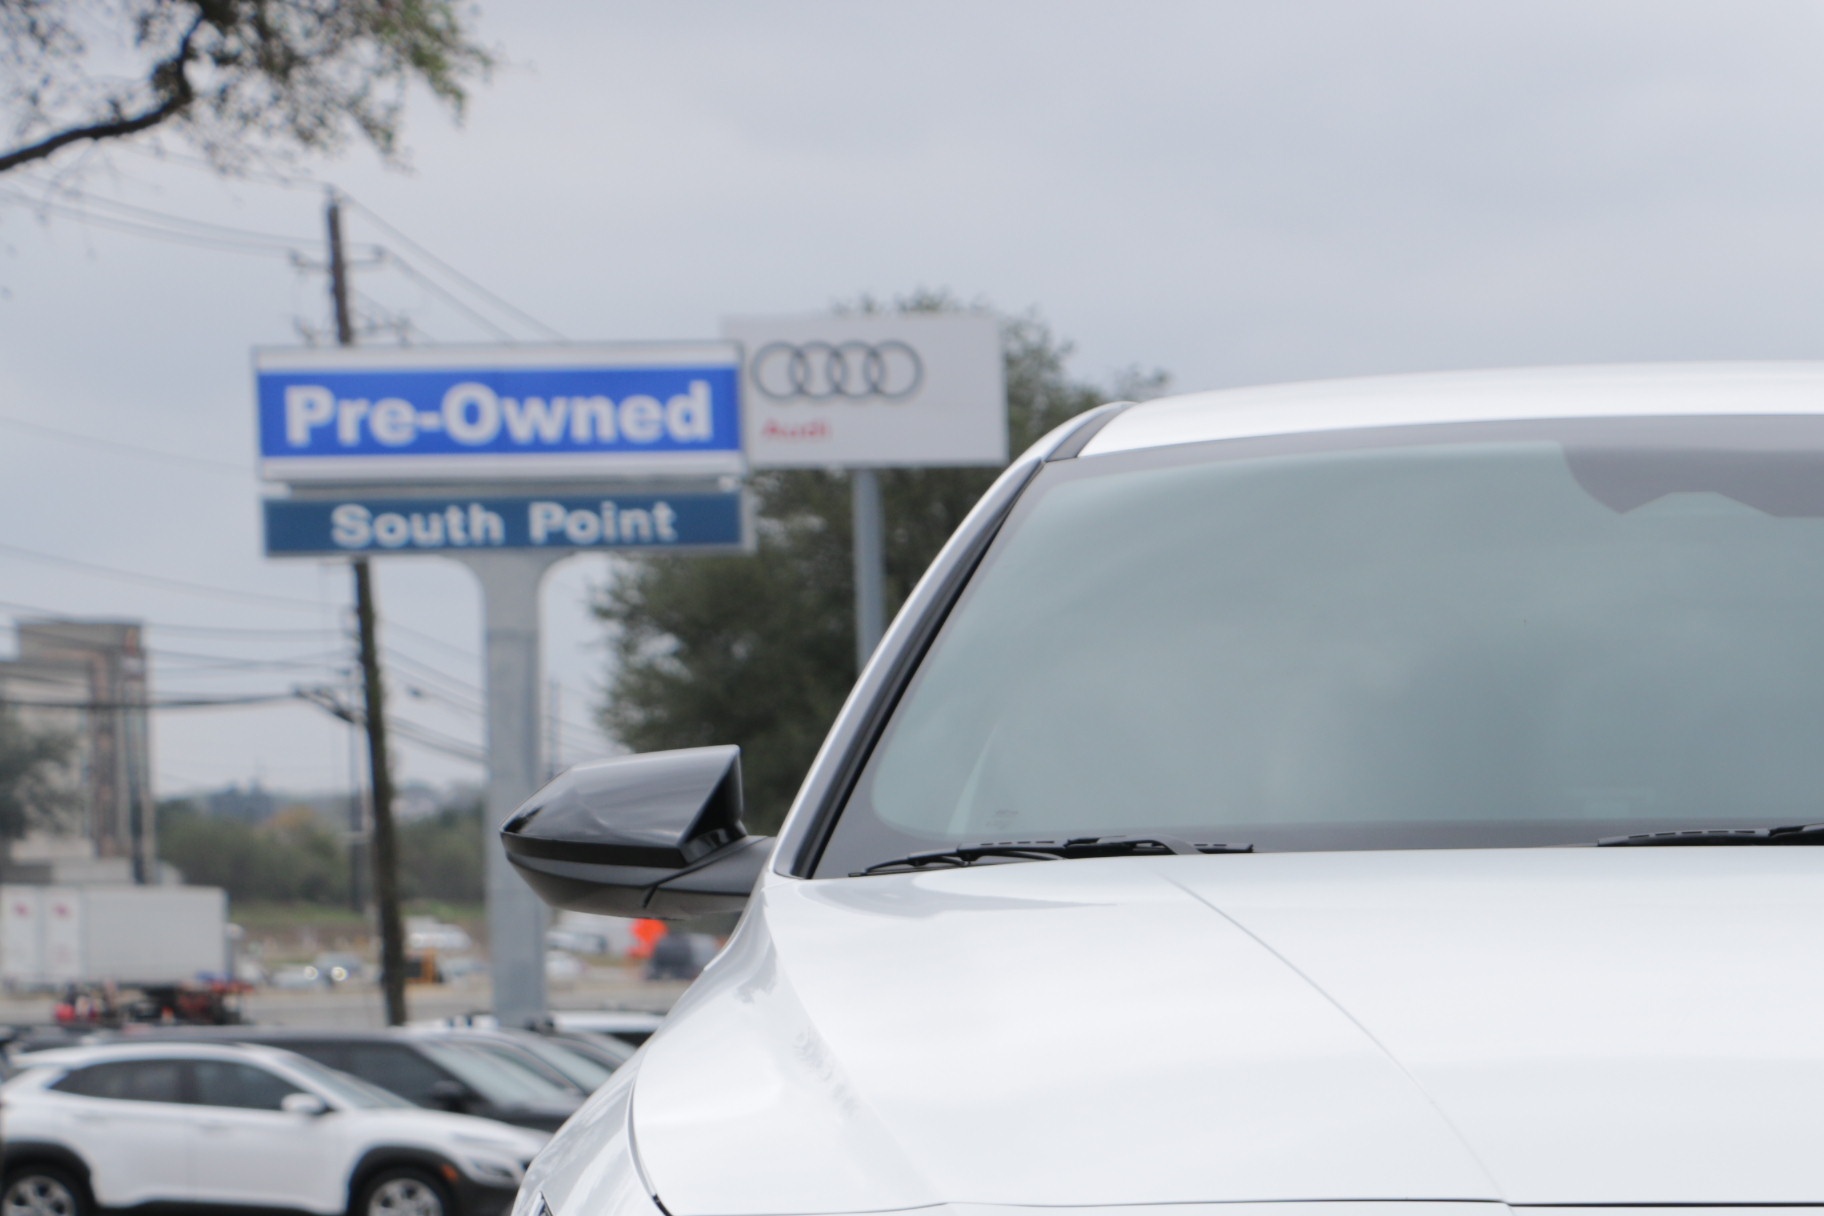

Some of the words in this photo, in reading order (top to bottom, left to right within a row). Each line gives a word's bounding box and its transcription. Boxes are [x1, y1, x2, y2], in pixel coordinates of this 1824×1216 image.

[285, 381, 714, 446] Pre-Owned
[762, 418, 831, 440] Audi
[332, 503, 504, 547] South
[529, 501, 678, 543] Point
